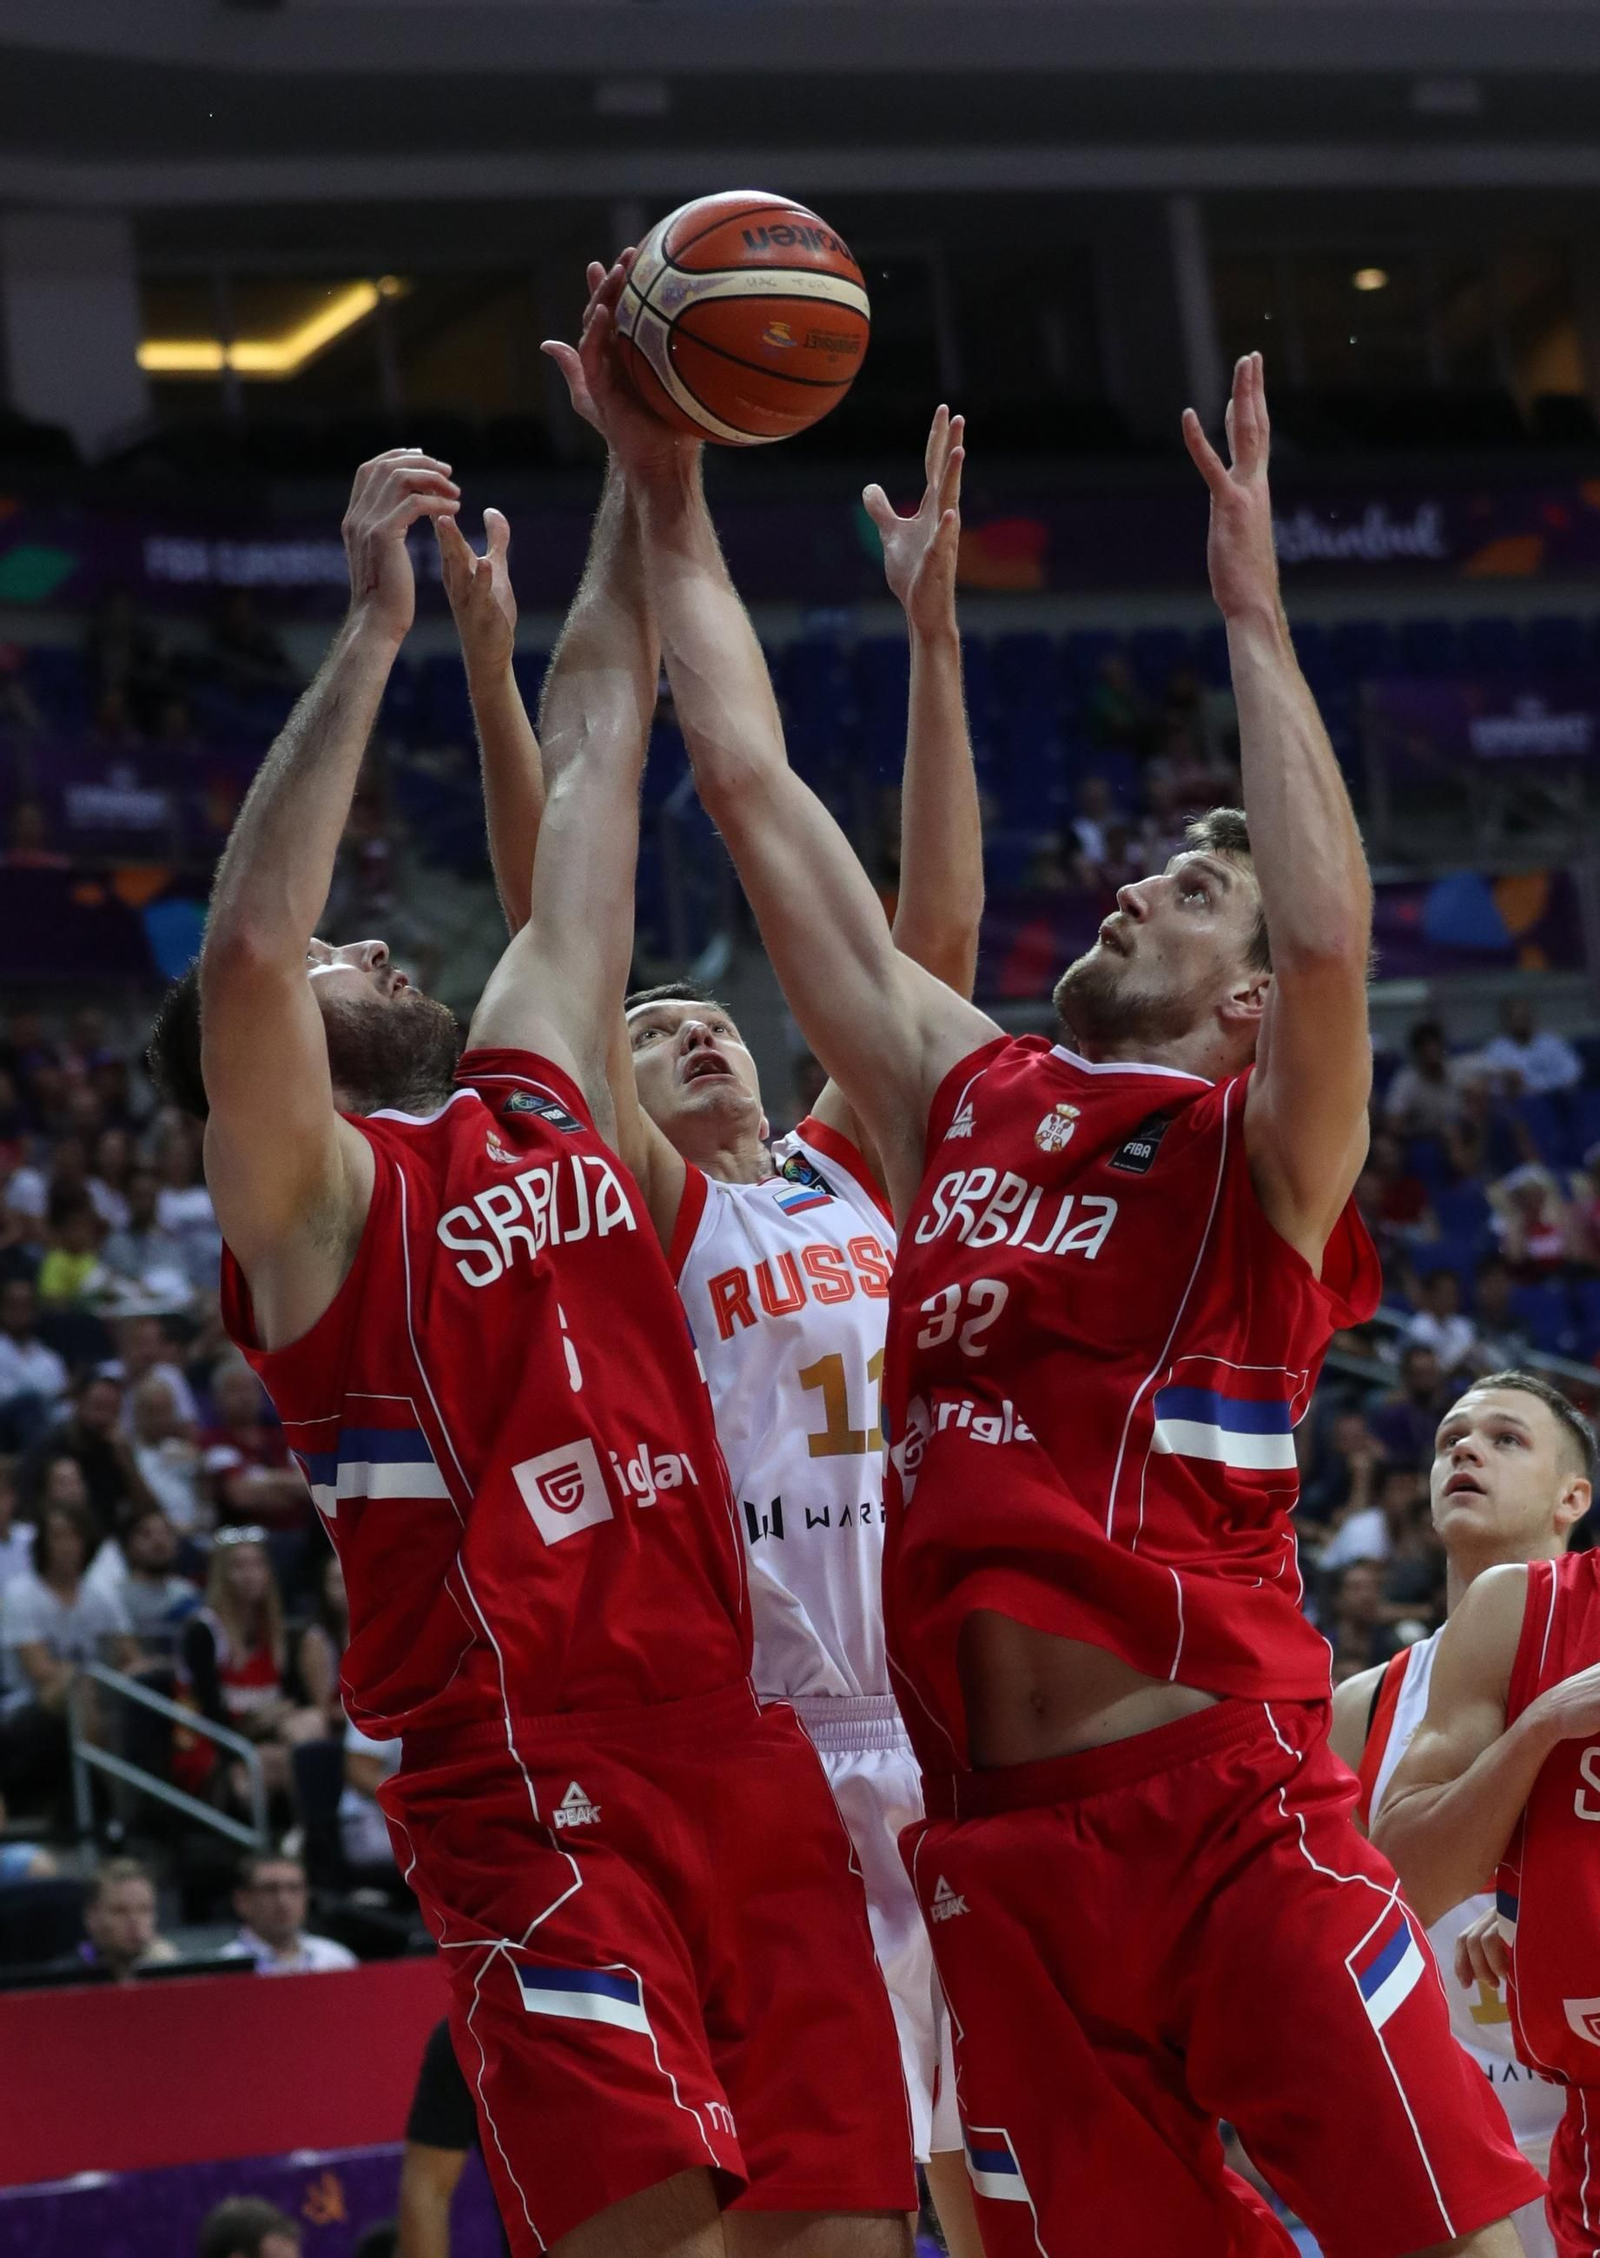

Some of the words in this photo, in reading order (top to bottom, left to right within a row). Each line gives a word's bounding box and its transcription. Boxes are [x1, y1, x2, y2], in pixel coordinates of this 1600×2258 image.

[1123, 1142, 1151, 1158] FIBA
[916, 1278, 1010, 1357] 32
[553, 1806, 601, 1829] PEAK
[929, 1895, 971, 1923] PEAK
